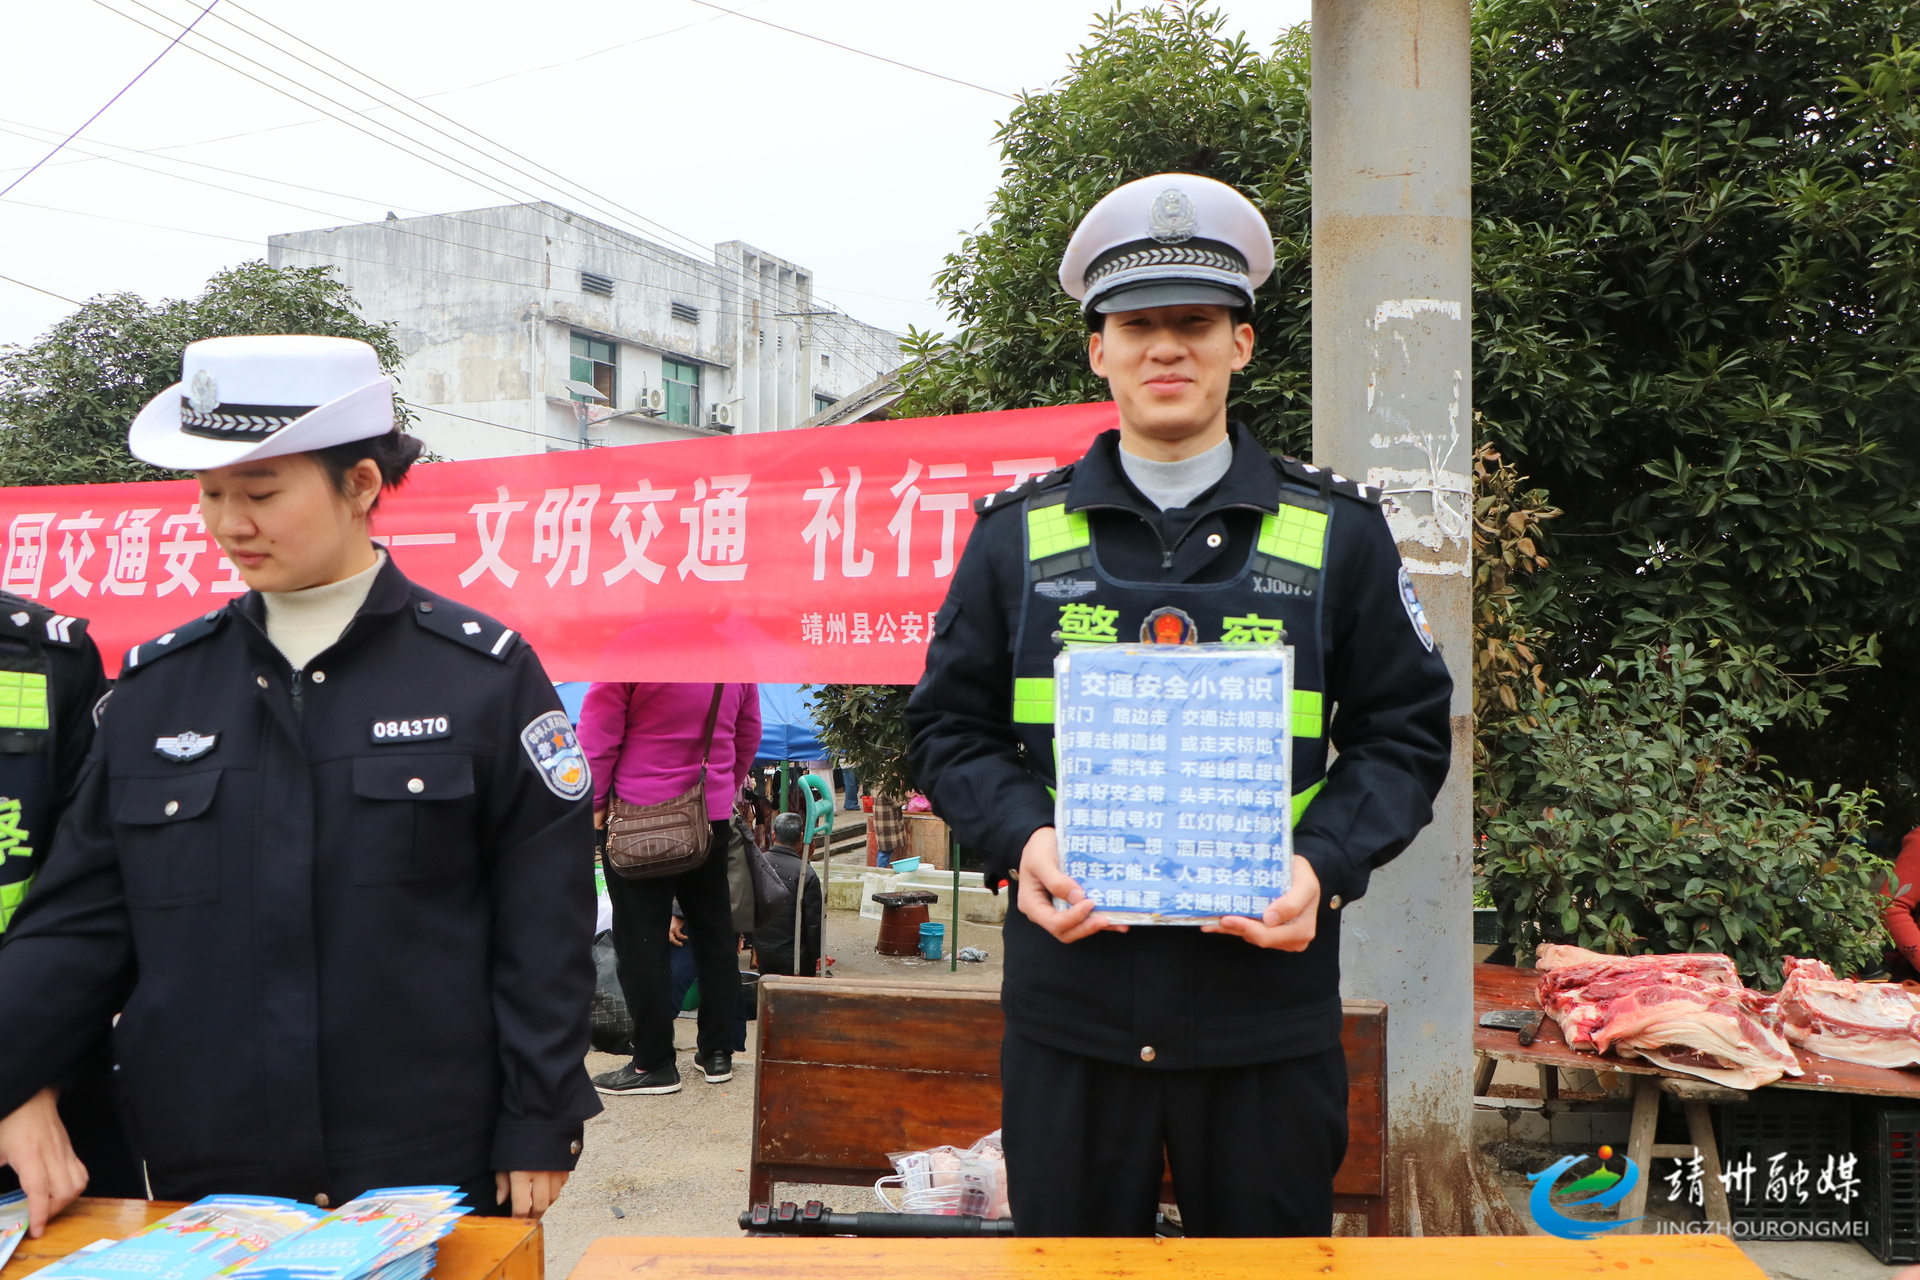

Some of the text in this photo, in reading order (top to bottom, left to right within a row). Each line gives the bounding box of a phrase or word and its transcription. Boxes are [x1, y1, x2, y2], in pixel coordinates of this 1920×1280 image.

[1080, 672, 1273, 701] 交通安全小常识
[1112, 707, 1168, 726] 路边走
[373, 717, 448, 738] 084370
[1111, 758, 1167, 776] 乘汽车
[1065, 835, 1163, 855] 时候想一想
[1065, 861, 1162, 882] 货车不能上
